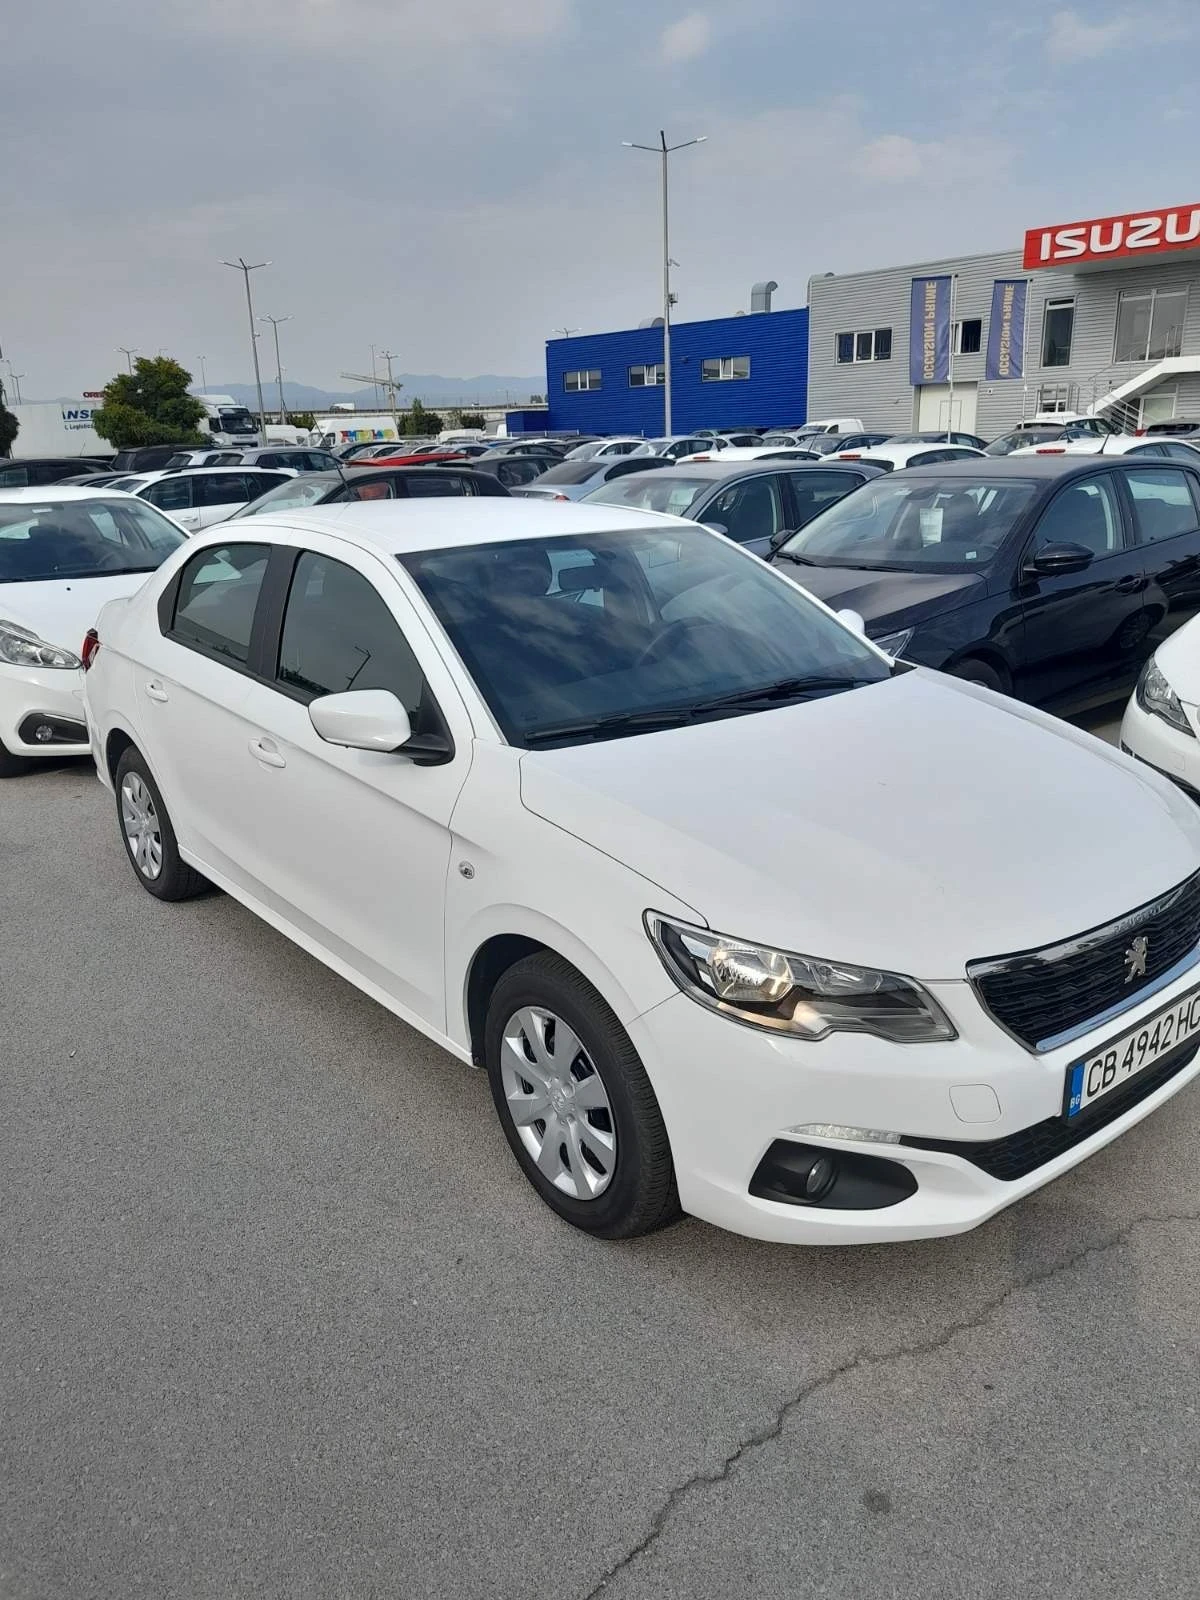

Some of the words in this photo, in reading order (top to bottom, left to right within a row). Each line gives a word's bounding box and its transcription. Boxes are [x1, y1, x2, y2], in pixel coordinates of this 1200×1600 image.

[1040, 209, 1200, 260] ISUZU
[1087, 1050, 1118, 1097] CB
[1122, 1014, 1174, 1072] 4942
[1070, 1094, 1081, 1108] BG
